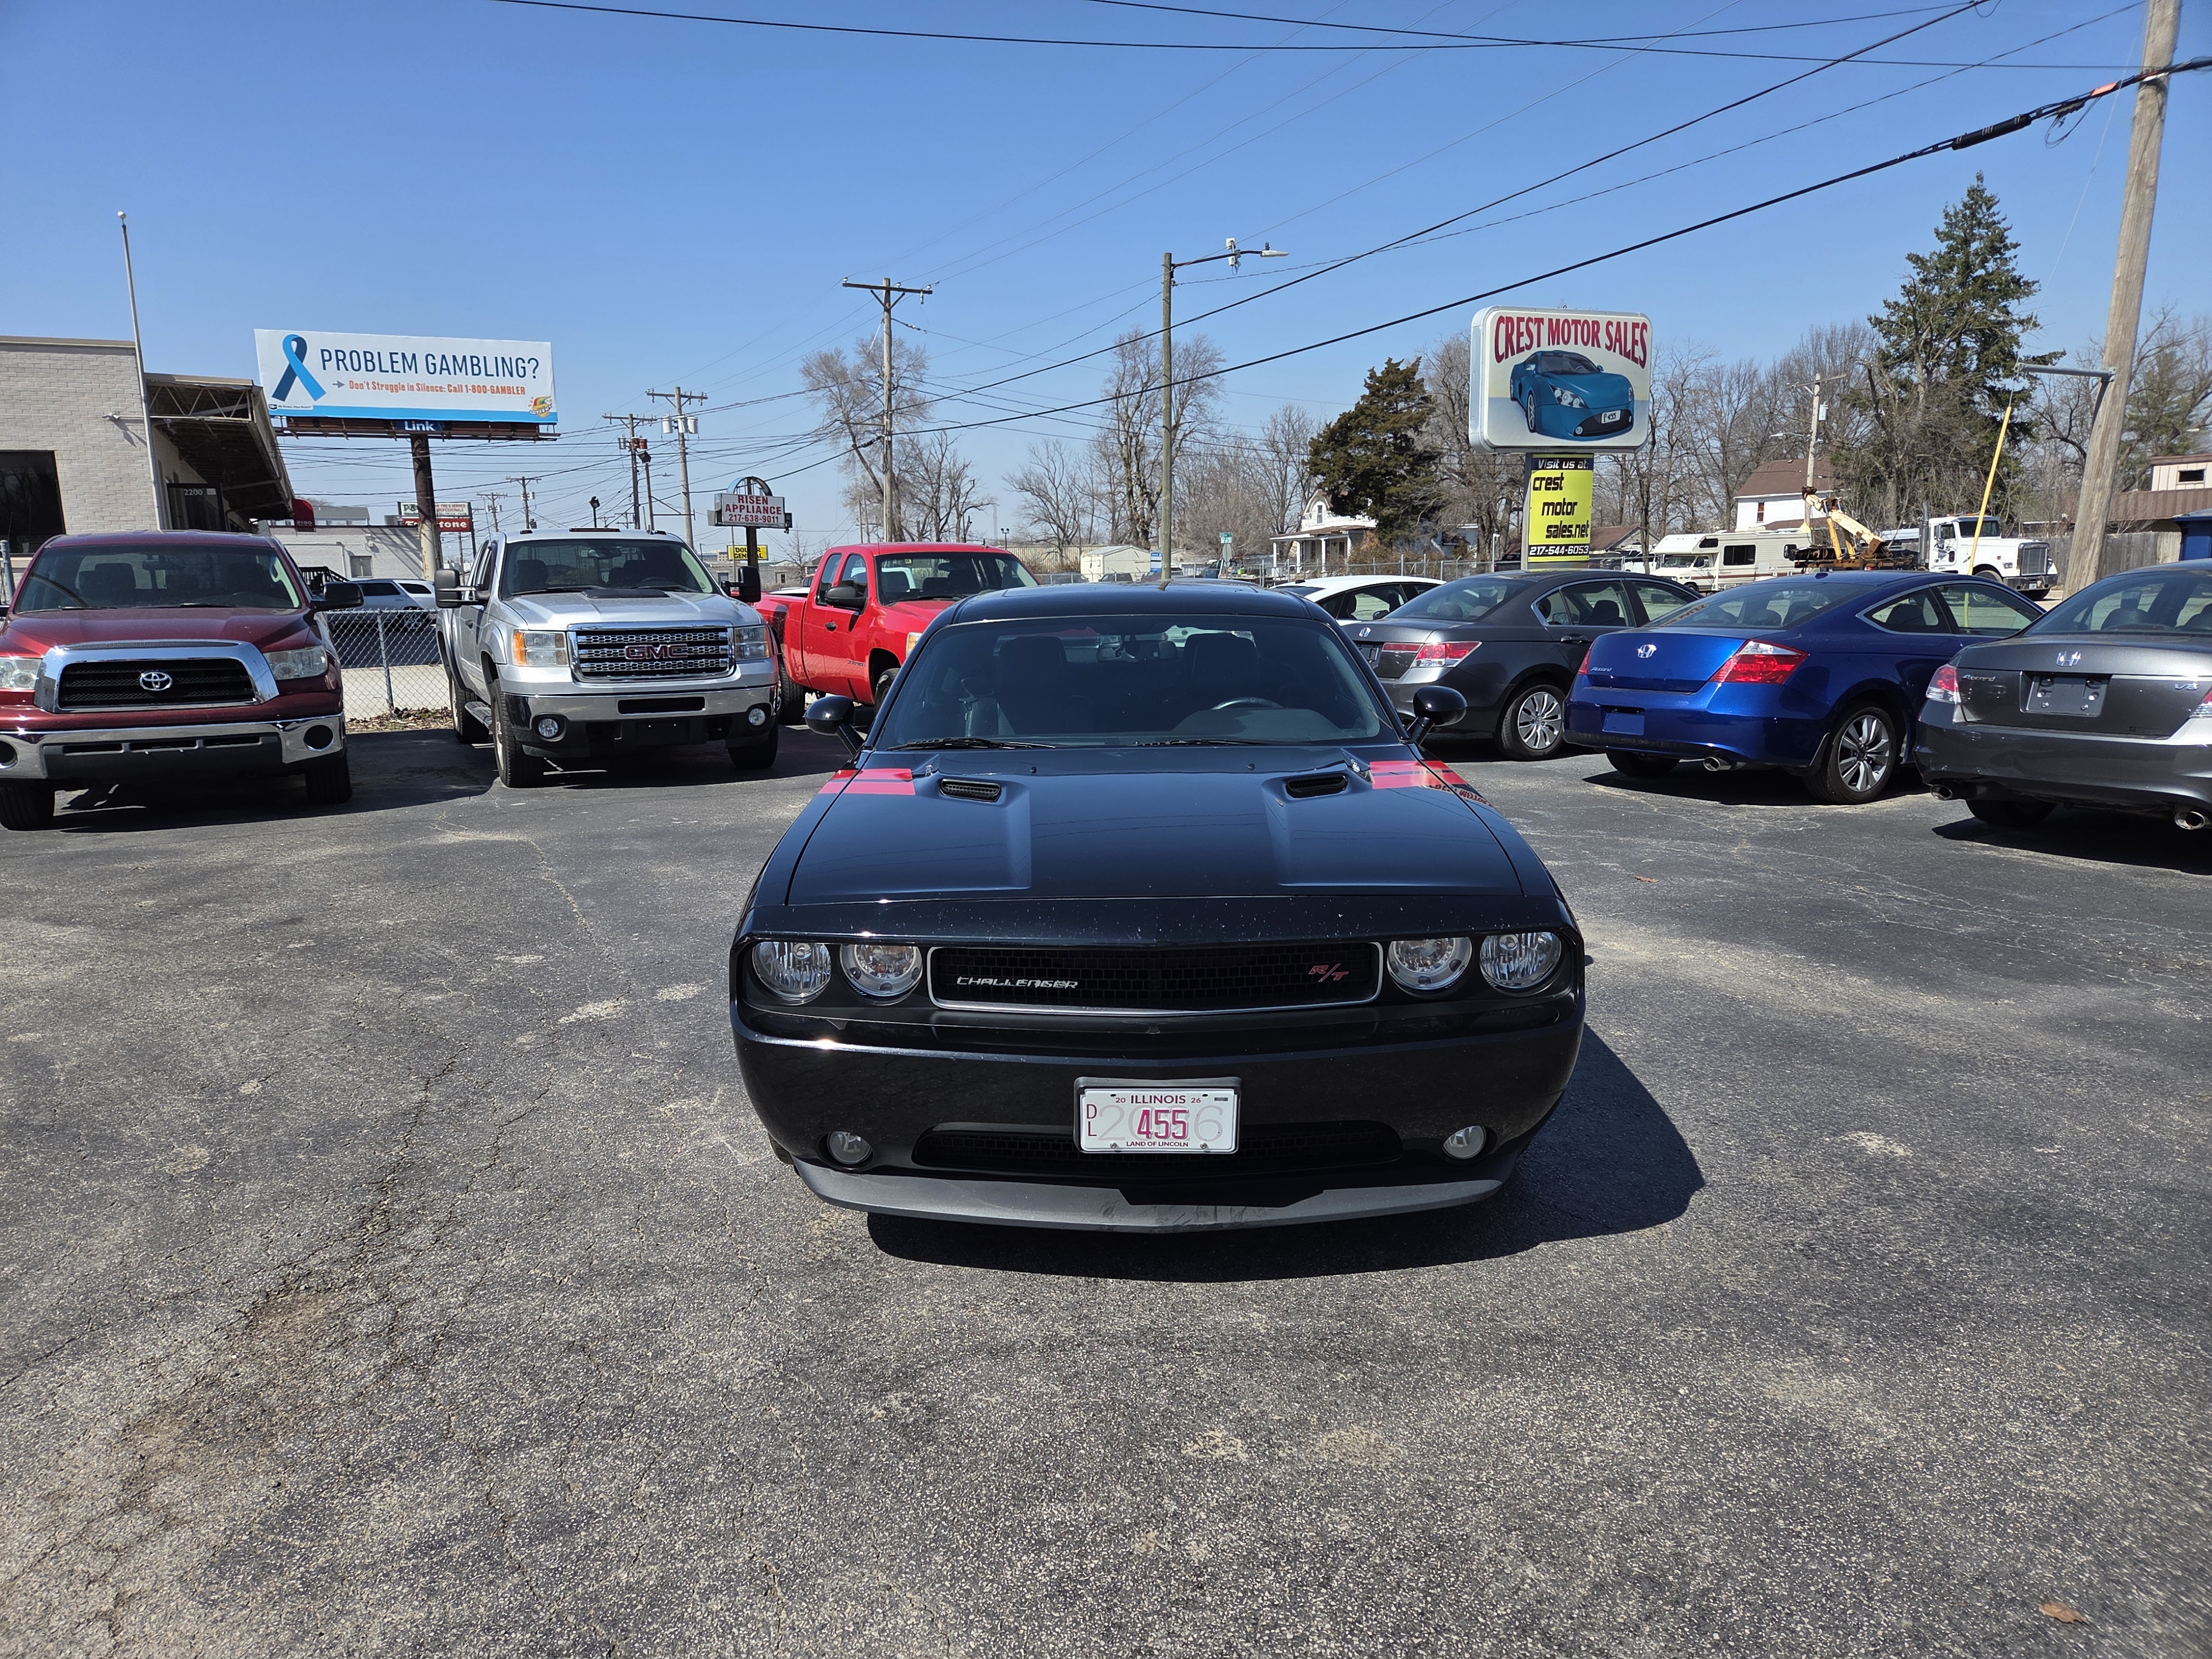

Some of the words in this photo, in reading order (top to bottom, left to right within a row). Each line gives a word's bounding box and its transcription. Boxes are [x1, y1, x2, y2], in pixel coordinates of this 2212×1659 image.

[1494, 315, 1544, 363] CREST
[1548, 317, 1601, 348] MOTOR
[1605, 320, 1648, 369] SALES
[320, 349, 418, 374] PROBLEM
[425, 353, 539, 379] GAMBLING?
[349, 380, 370, 390] Don't
[372, 381, 405, 393] Struggle
[416, 382, 446, 393] Silence:
[447, 384, 463, 393] Call
[465, 384, 525, 395] 1-800-GAMBLER
[404, 421, 436, 431] Link
[1538, 459, 1559, 469] Visit
[1578, 459, 1589, 469] at:
[1532, 472, 1564, 491] crest
[738, 495, 768, 504] RISEN
[1541, 498, 1578, 516] motor
[725, 504, 782, 515] APPLIANCE
[729, 514, 779, 523] 217-638-9011
[1546, 520, 1590, 539] sales.net
[1530, 545, 1589, 556] 217-544-6053
[625, 644, 688, 660] GMC
[1308, 963, 1349, 982] R/T
[956, 977, 1078, 989] CHALLENGER
[1130, 1095, 1186, 1103] ILLINOIS
[1137, 1109, 1187, 1139] 455
